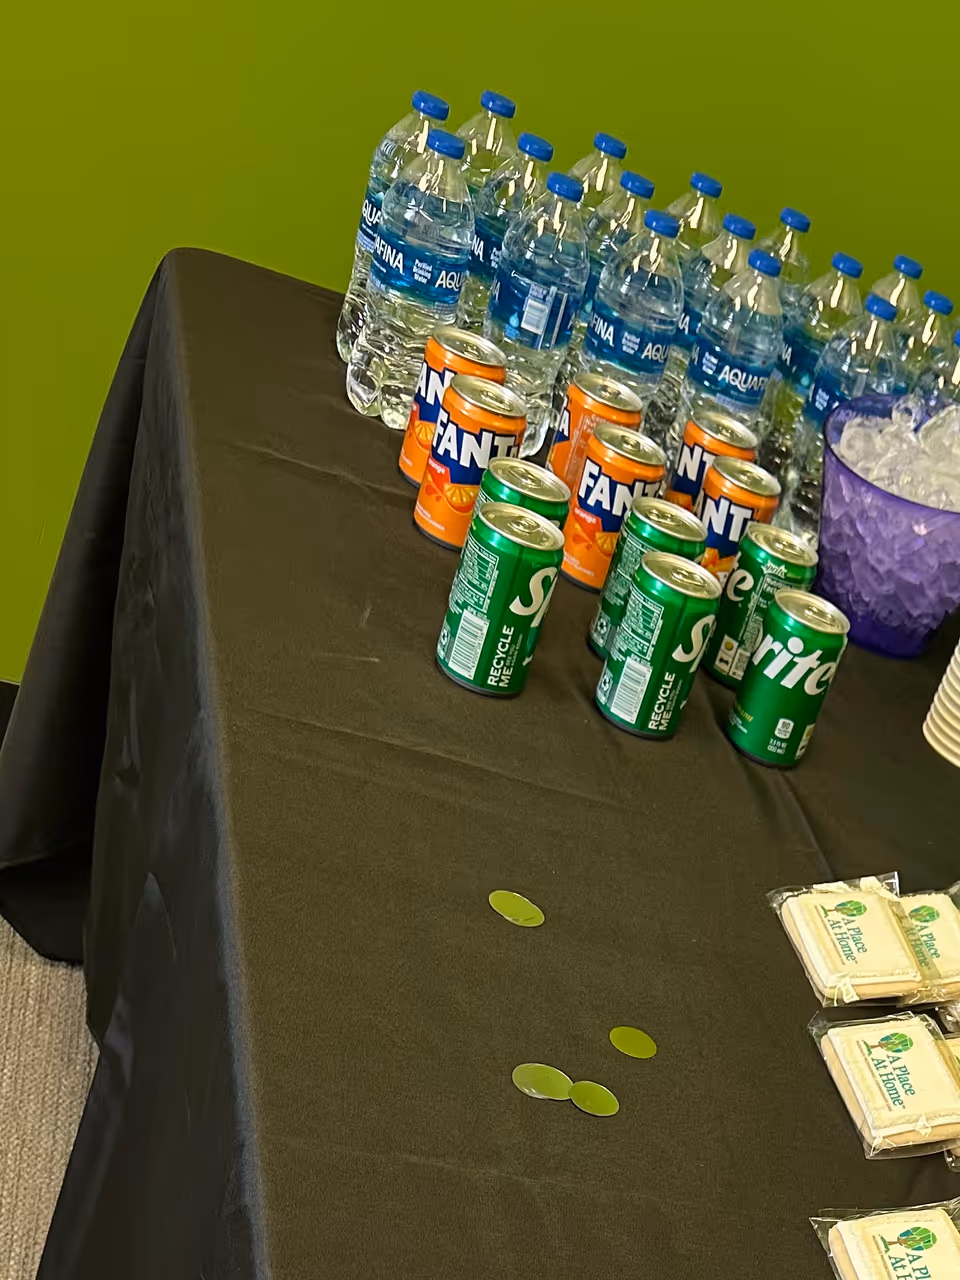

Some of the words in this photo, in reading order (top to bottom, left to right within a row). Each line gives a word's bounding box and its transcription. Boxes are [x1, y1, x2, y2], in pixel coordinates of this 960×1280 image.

[487, 624, 515, 686] RECYCLE
[498, 664, 513, 688] ME
[648, 672, 676, 731] RECYCLE
[658, 710, 672, 731] ME
[827, 919, 842, 930] At
[841, 912, 855, 925] A
[914, 919, 928, 932] A
[902, 922, 916, 938] At
[846, 926, 867, 953] Place
[920, 932, 940, 958] Place
[870, 1057, 888, 1070] At
[886, 1049, 901, 1064] A
[893, 1064, 915, 1095] Place
[887, 1255, 906, 1271] At
[905, 1247, 922, 1264] A
